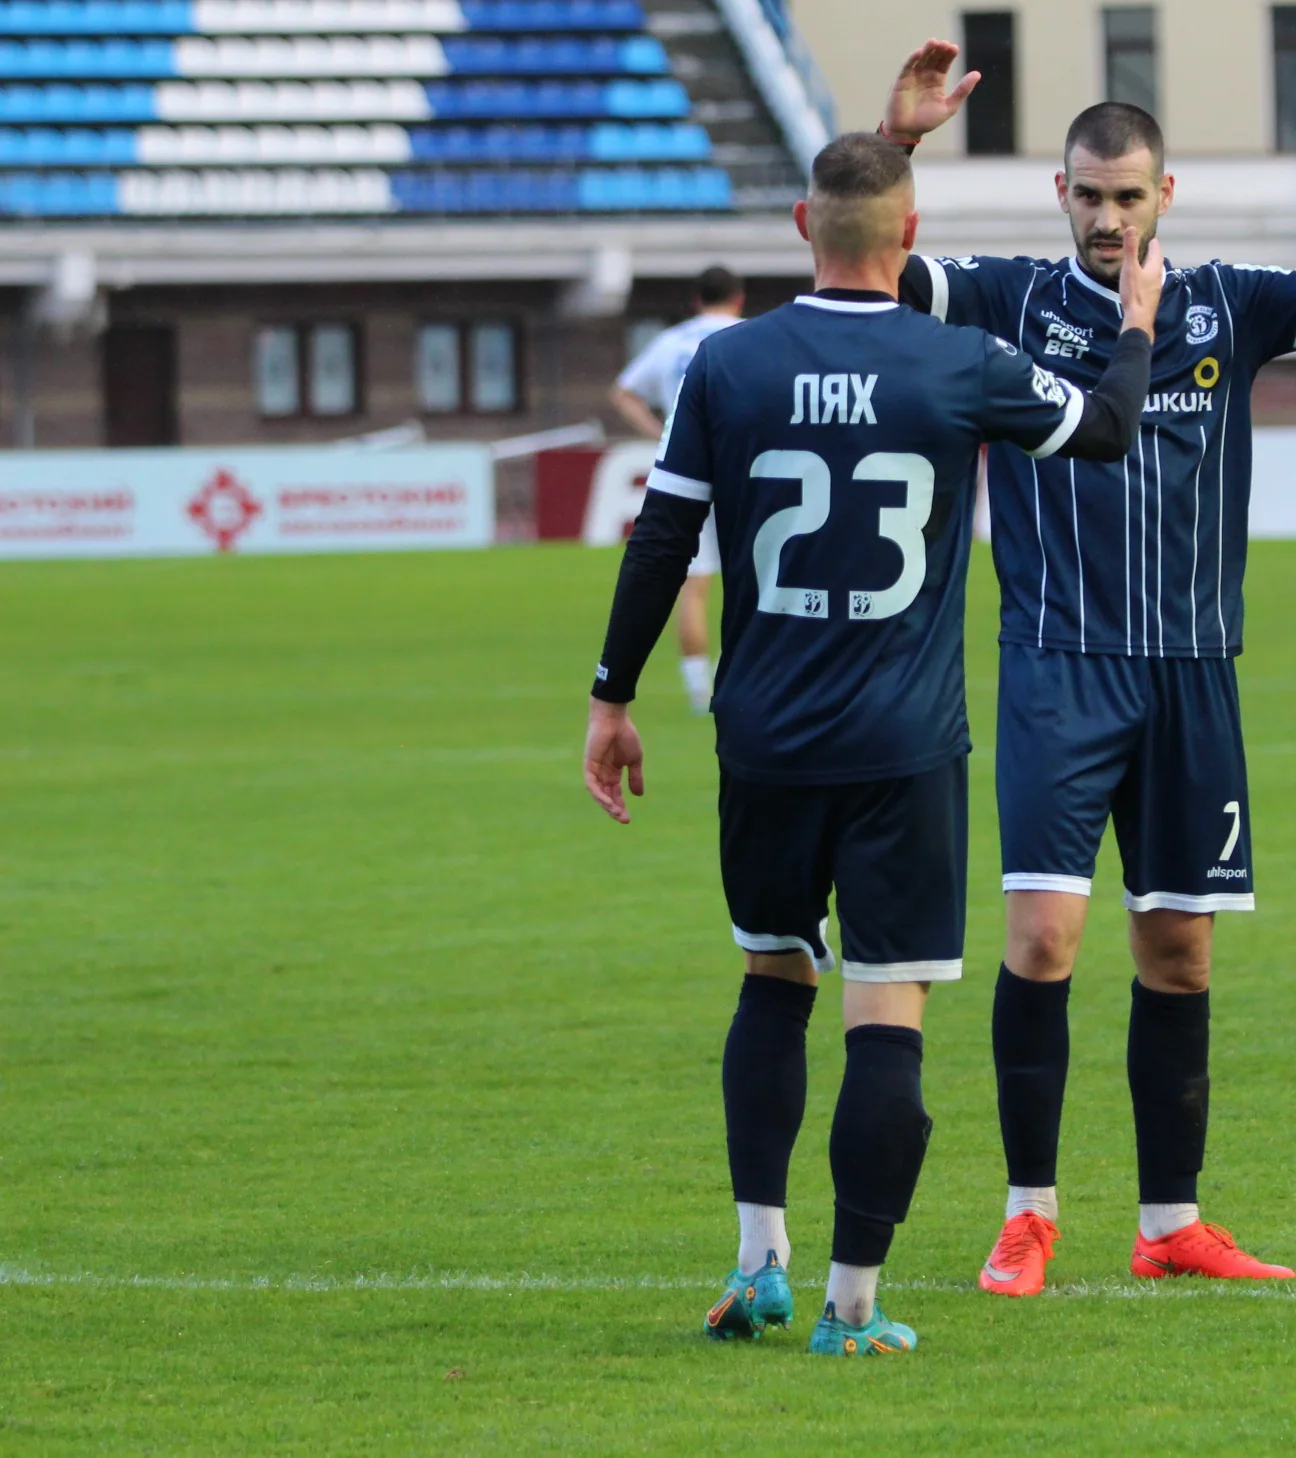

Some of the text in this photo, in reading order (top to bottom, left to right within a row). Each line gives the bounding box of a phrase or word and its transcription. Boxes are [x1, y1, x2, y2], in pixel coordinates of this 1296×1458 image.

[1043, 339, 1091, 360] BET
[1045, 322, 1089, 346] FON
[790, 373, 879, 425] ЛЯХ
[749, 449, 936, 621] 23
[1218, 800, 1241, 861] 7
